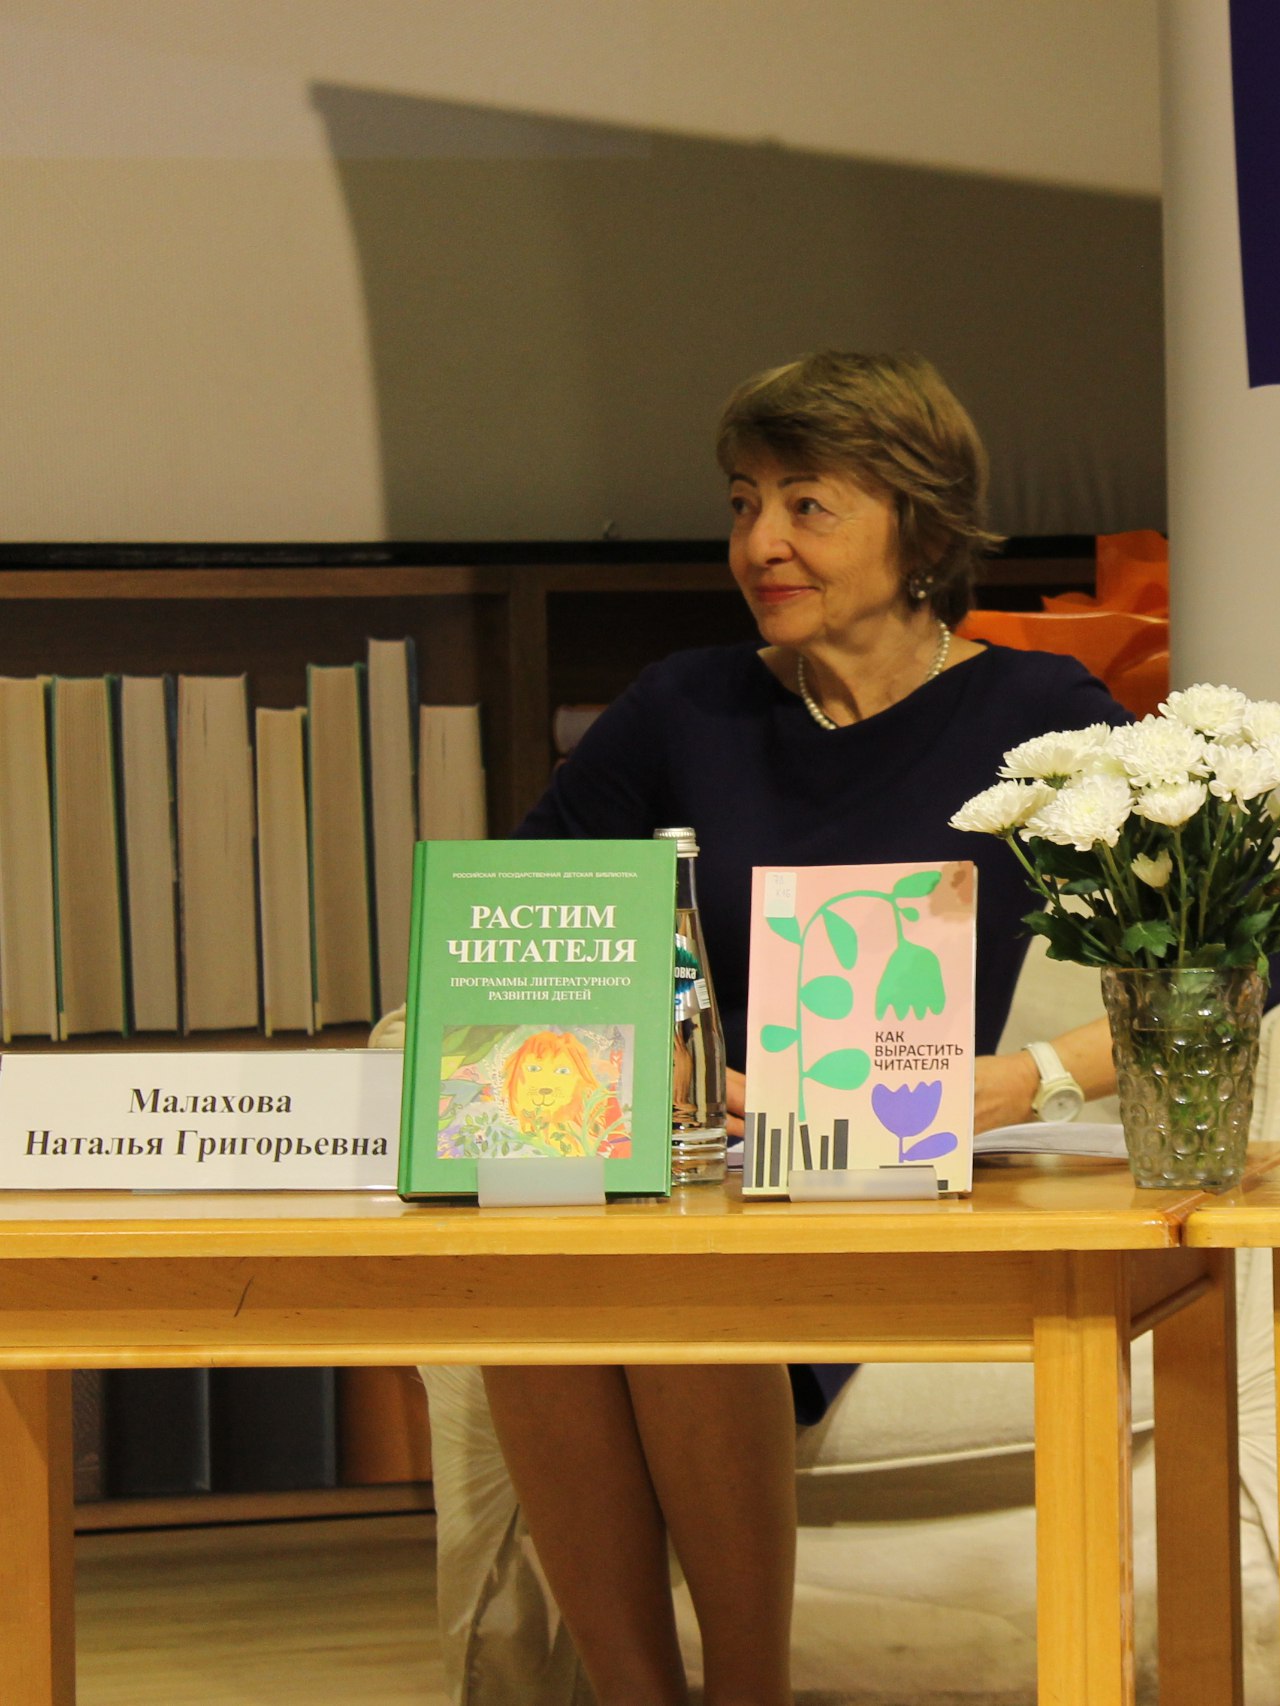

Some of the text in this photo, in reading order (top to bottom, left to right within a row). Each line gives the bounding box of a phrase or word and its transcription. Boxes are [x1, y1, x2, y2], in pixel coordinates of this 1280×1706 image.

[469, 904, 617, 929] РАСТИМ
[446, 939, 638, 963] ЧИТАТЕЛЯ
[450, 976, 631, 987] ПРОГРАММЫ ЛИТЕРАТУРНОГО
[488, 988, 592, 1002] РАЗВИТИЯ ДЕТЕЙ
[875, 1031, 906, 1044] КАК
[875, 1043, 964, 1057] ВЫРАСТИТЬ
[874, 1058, 950, 1071] ЧИТАТЕЛЯ
[128, 1087, 293, 1115] Малахова
[24, 1129, 389, 1163] Наталья Григорьевна
